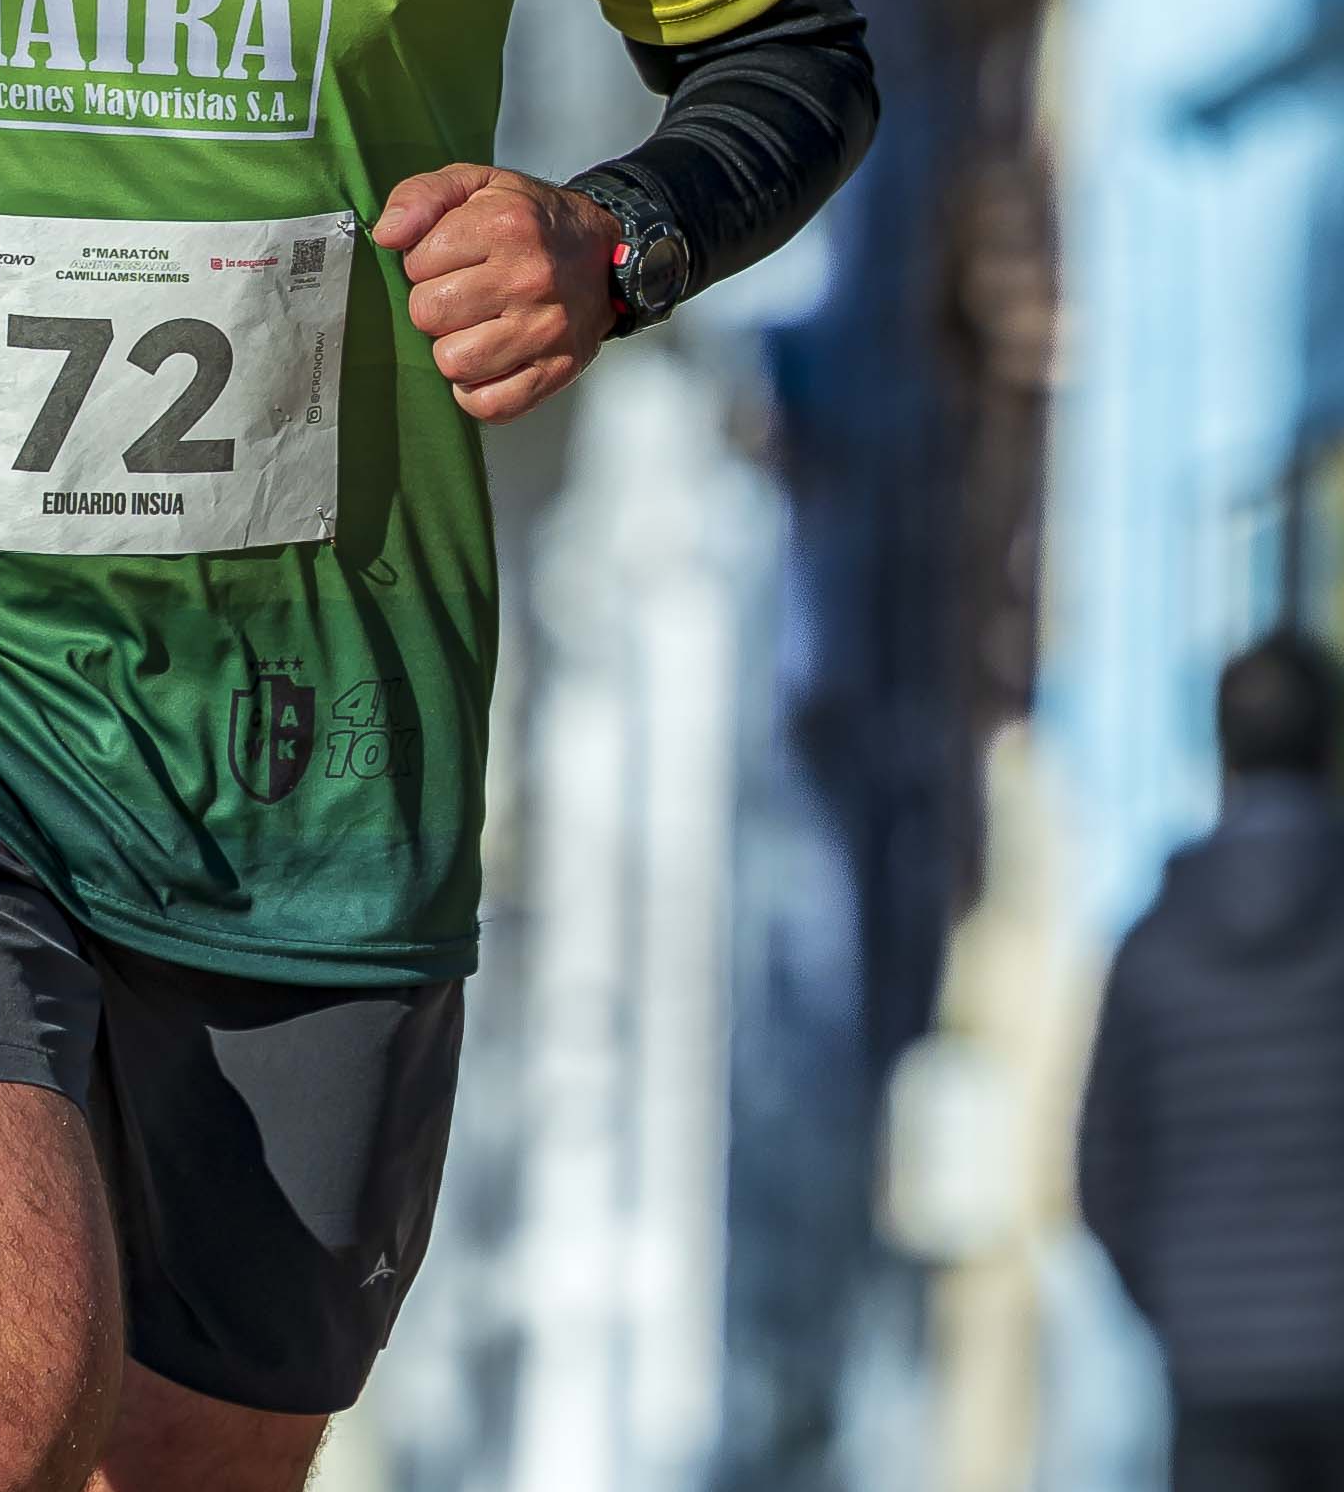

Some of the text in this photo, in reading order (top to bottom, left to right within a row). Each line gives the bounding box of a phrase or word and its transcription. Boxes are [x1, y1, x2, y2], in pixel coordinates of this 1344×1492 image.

[84, 82, 237, 121] Mayoristas
[246, 91, 295, 122] S.A.
[55, 270, 191, 283] CAWILLIAMSKEMMIS
[225, 258, 236, 268] la
[310, 331, 326, 404] @CRONORAV
[7, 313, 236, 474] 72
[42, 492, 185, 515] EDUARDO INSUA
